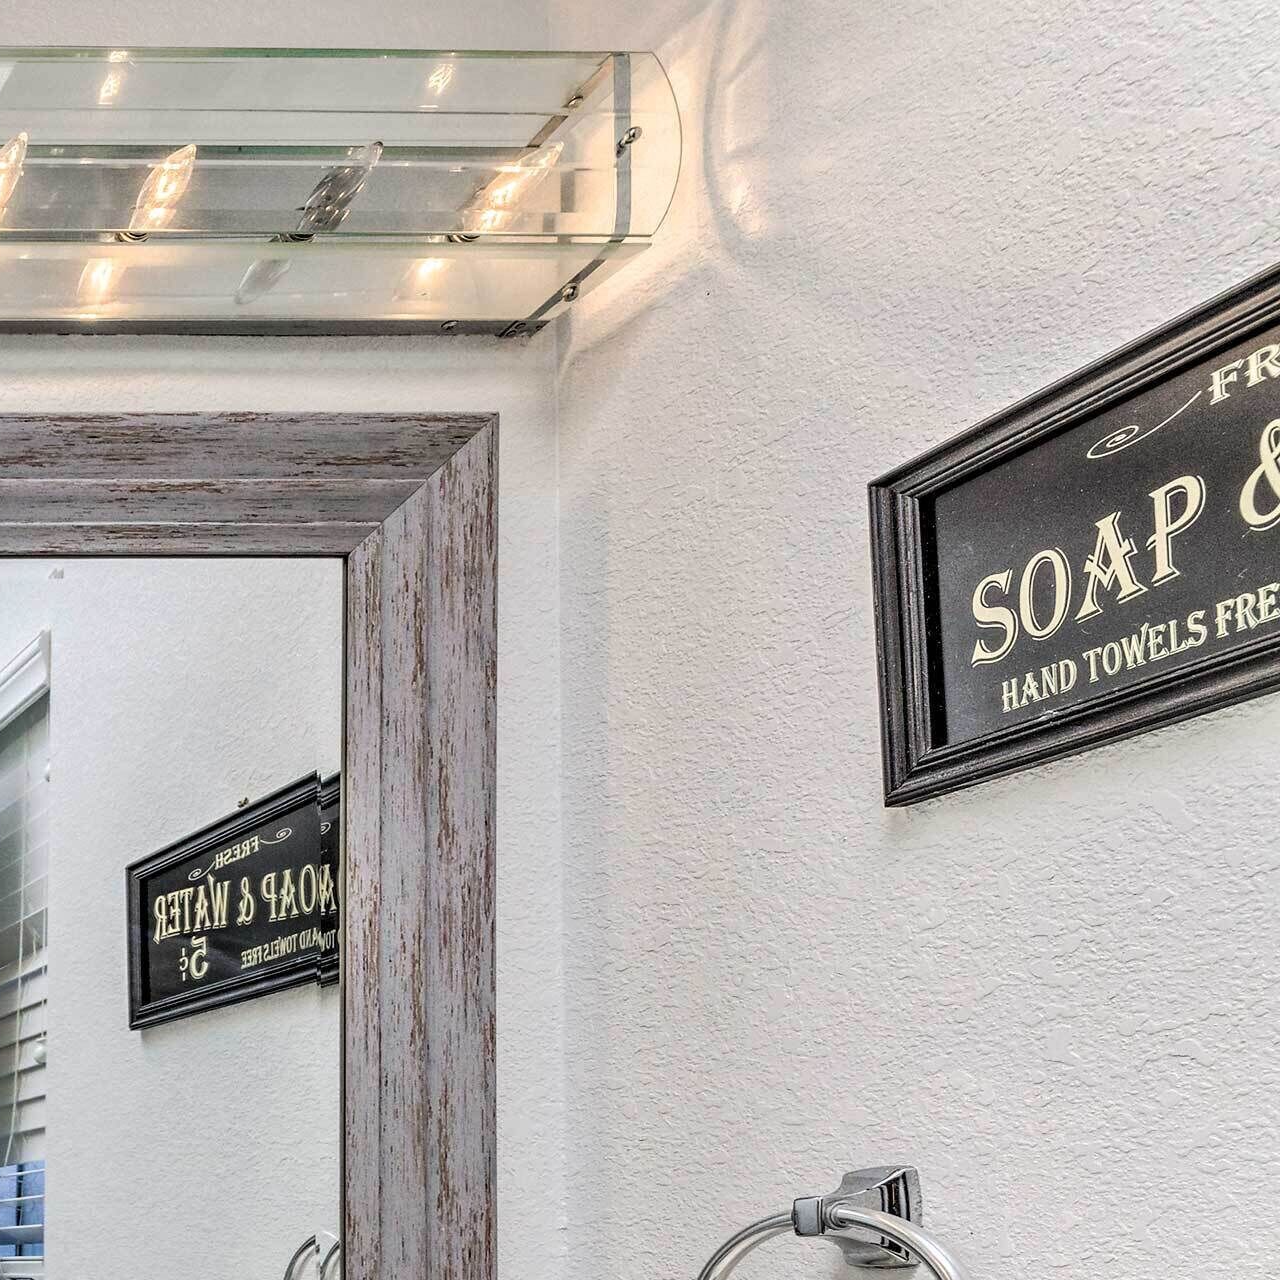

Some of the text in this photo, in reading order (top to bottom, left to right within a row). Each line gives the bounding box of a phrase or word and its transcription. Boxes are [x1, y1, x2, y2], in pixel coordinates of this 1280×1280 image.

[971, 474, 1205, 667] SOAP
[1001, 658, 1077, 714] HAND
[1083, 610, 1207, 682] TOWELS
